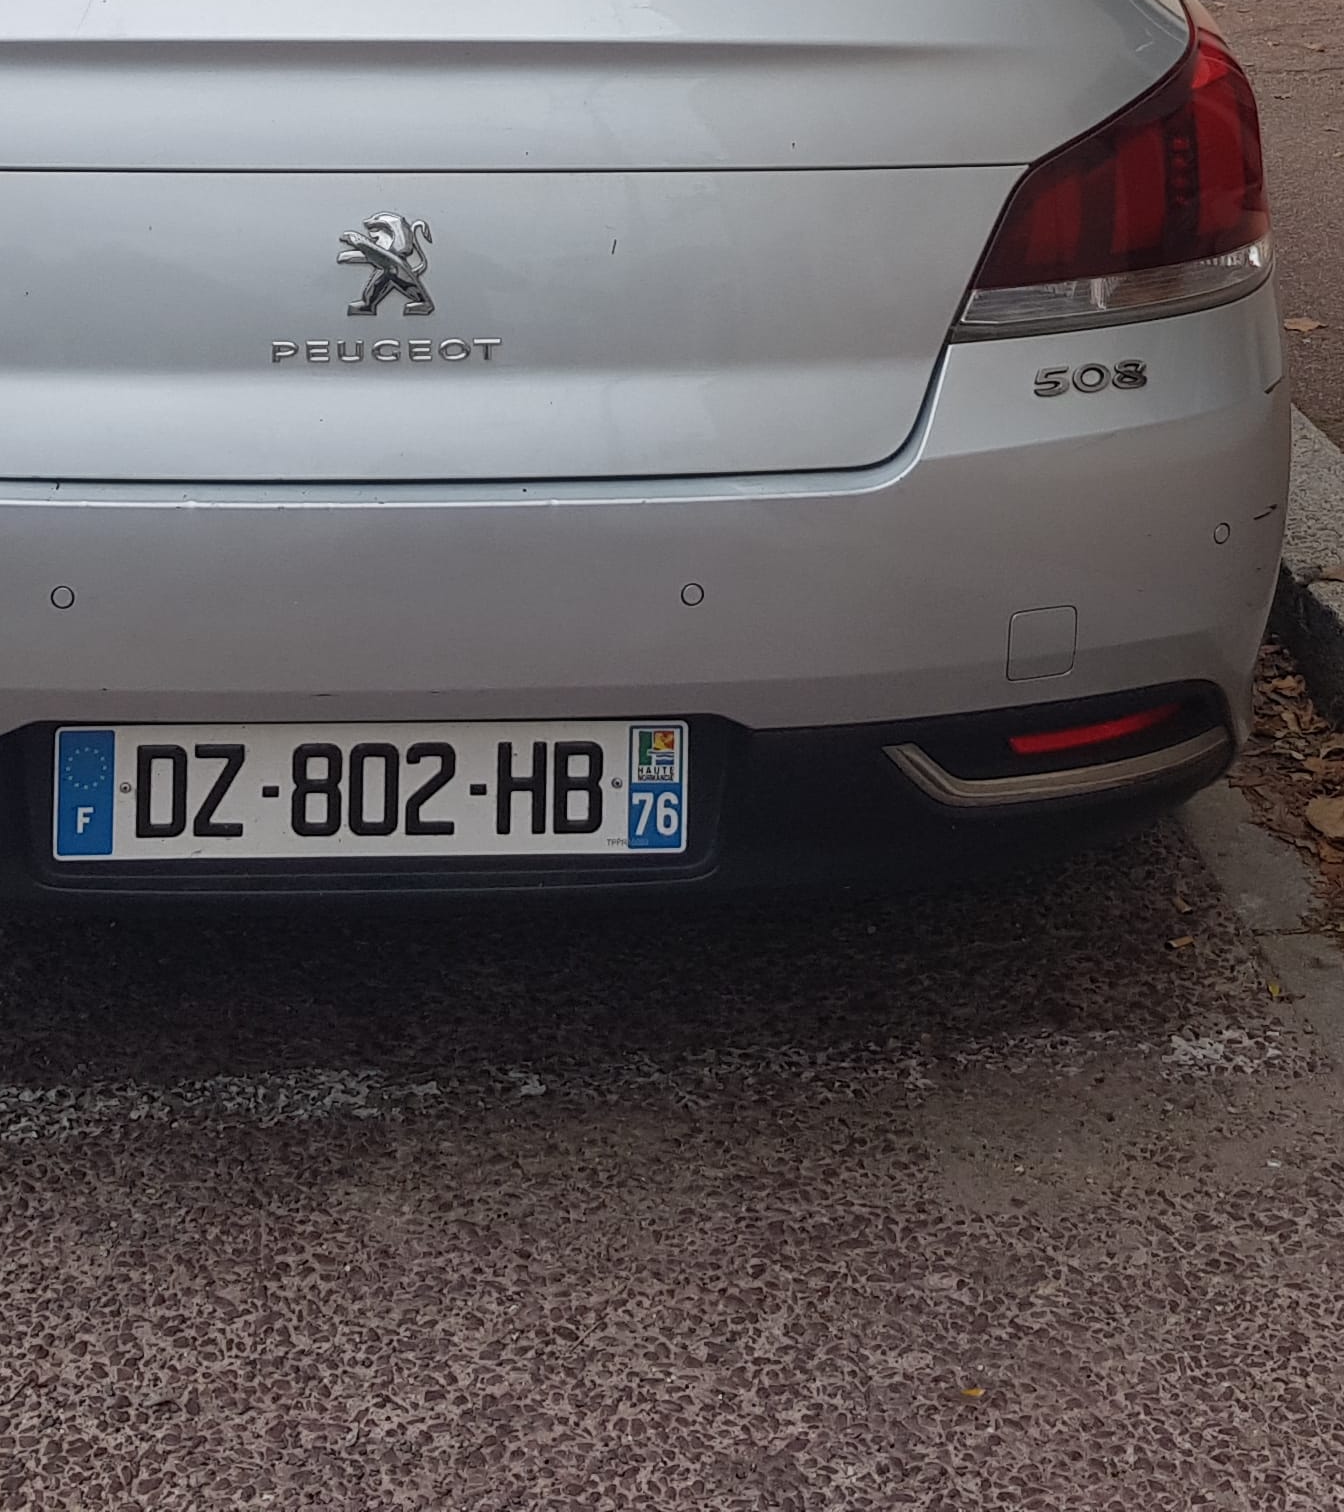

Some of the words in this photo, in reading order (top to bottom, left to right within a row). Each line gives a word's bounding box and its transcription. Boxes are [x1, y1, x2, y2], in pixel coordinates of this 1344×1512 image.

[270, 338, 503, 363] PEUGEOT
[1034, 359, 1148, 397] 508
[638, 766, 674, 774] HAUTE
[135, 741, 604, 838] DZ-802-HB
[76, 807, 94, 833] F
[632, 791, 679, 836] 76
